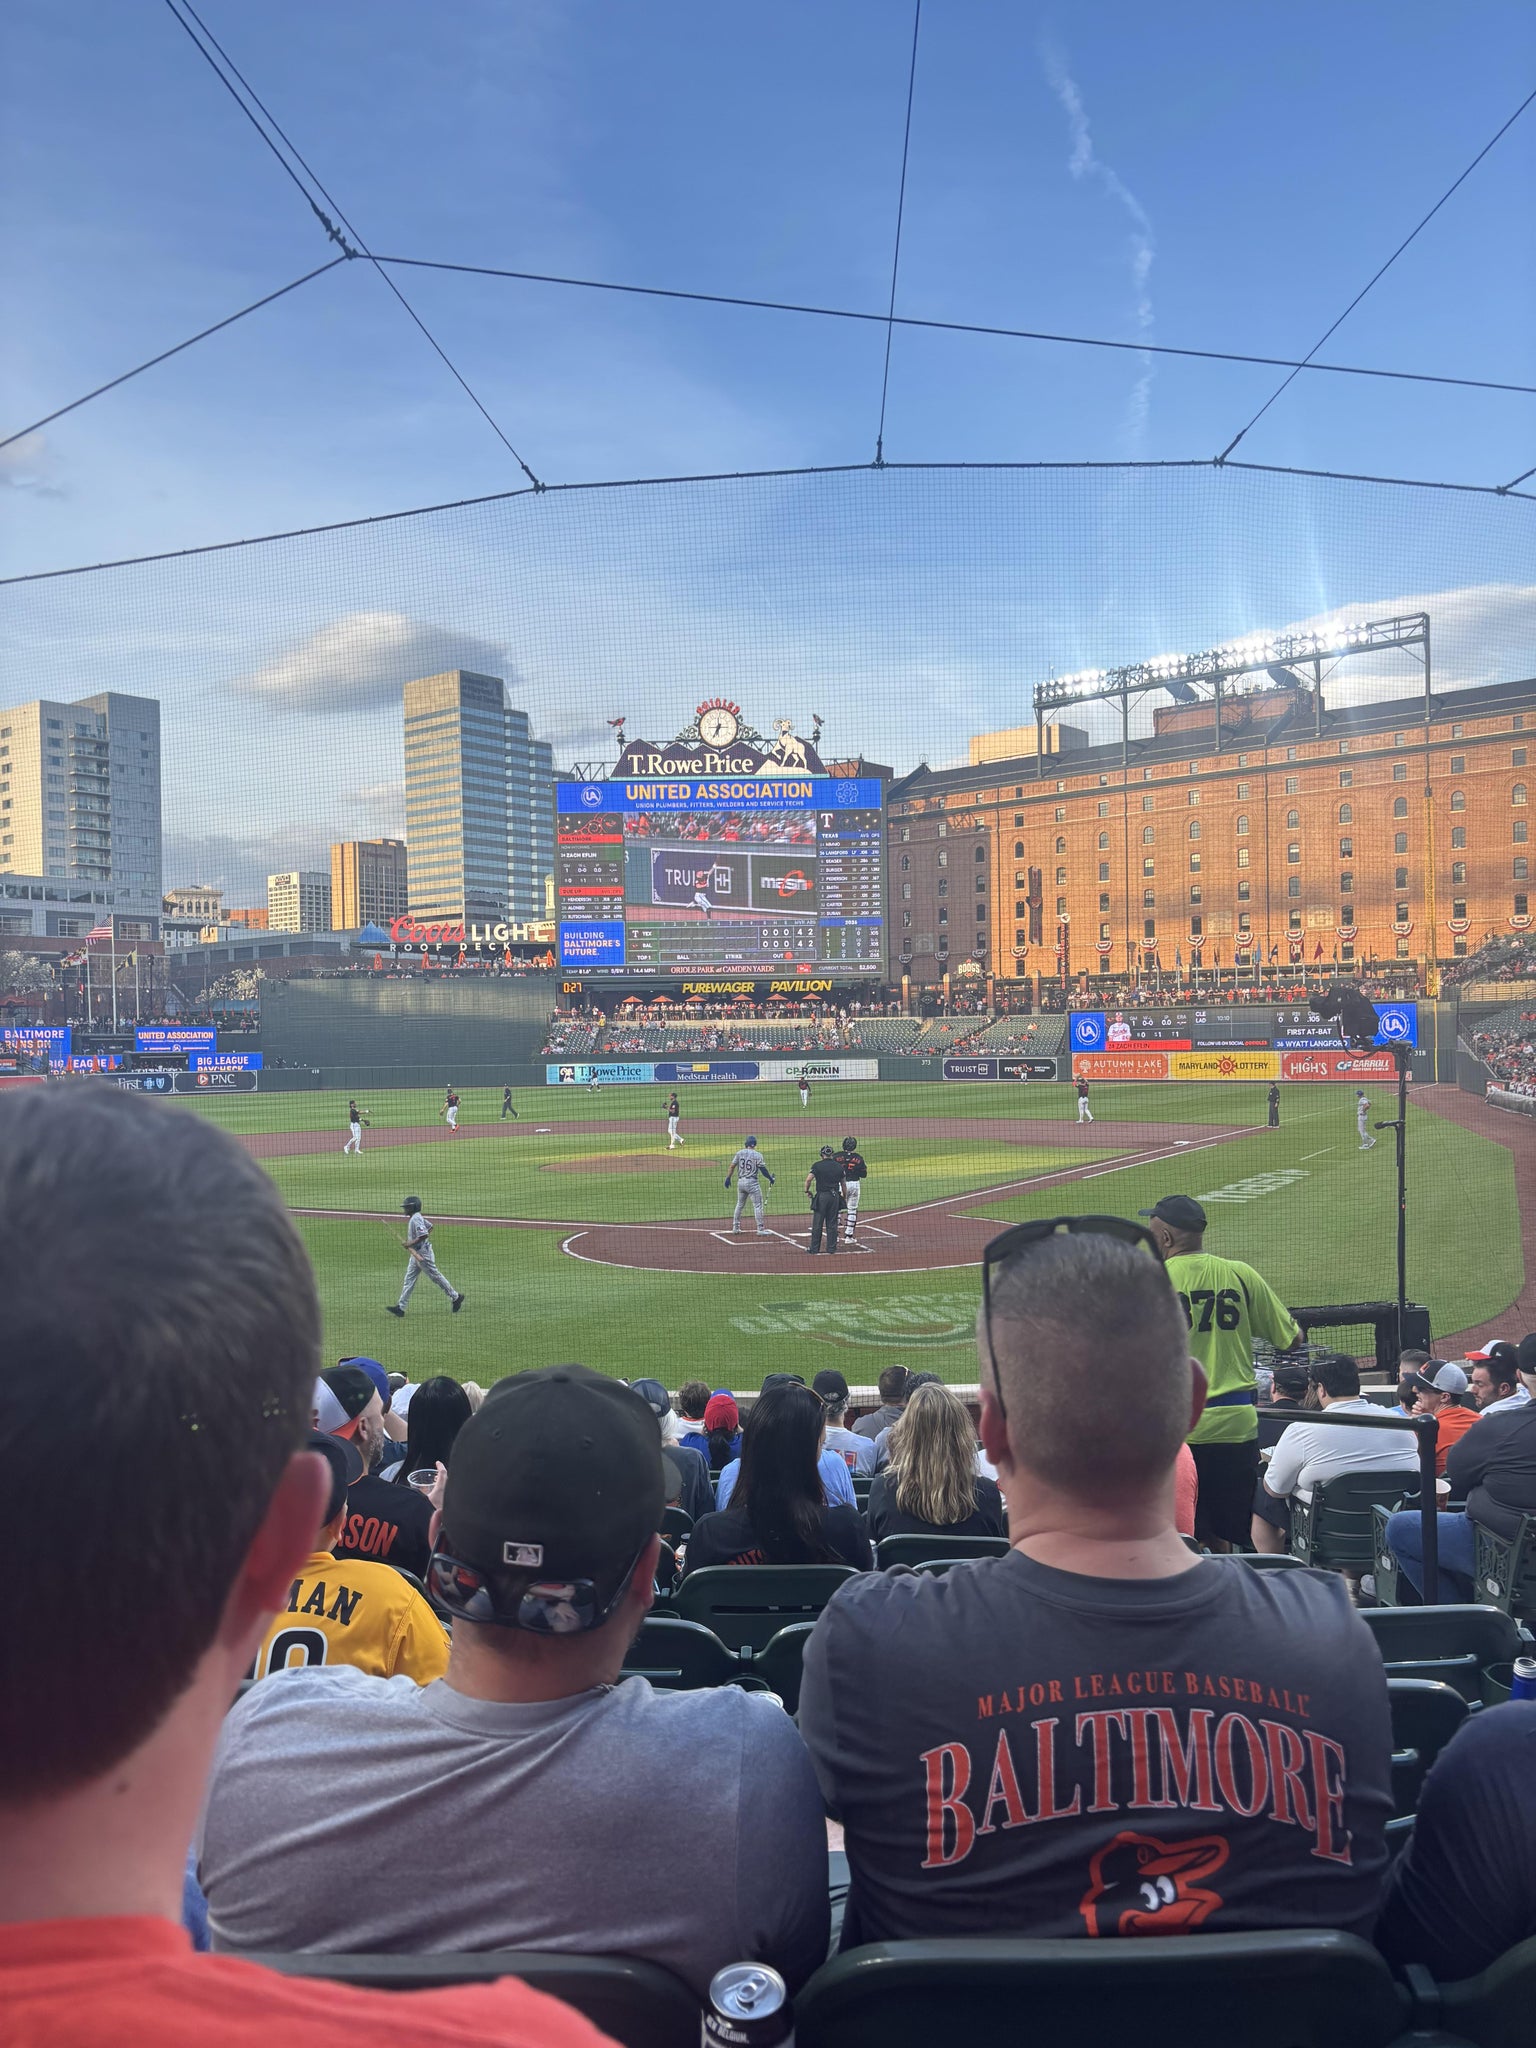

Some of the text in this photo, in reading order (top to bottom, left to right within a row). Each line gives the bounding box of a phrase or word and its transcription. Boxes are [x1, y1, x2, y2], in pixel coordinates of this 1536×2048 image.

[626, 782, 813, 800] UNITED ASSOCIATION
[821, 813, 833, 828] T
[389, 914, 550, 943] Coors LIGHT
[783, 928, 789, 936] 0
[797, 928, 803, 936] 4
[807, 928, 813, 936] 2
[564, 932, 605, 940] BUILDING
[390, 941, 511, 952] ROOF DECK
[564, 940, 620, 948] BALTIMORE'S
[773, 940, 779, 948] 0
[564, 948, 600, 956] FUTURE.
[670, 966, 697, 974] ORIOLE
[563, 982, 582, 993] 0:27
[681, 980, 832, 994] PUREWAGER PAVILION
[4, 1029, 65, 1039] BALTIMORE
[138, 1031, 214, 1039] UNITED ASSOCIATION
[197, 1056, 249, 1065] BIG LEAGUE
[1093, 1059, 1162, 1068] AUTUMN LAKE
[1352, 1059, 1390, 1068] CARROLL
[950, 1065, 977, 1073] TRUIST
[1179, 1062, 1268, 1070] MARYLAND LOTTERY
[1290, 1061, 1328, 1076] HIGH'S
[211, 1074, 235, 1084] PNC
[677, 1071, 737, 1080] MedStar Health
[740, 1158, 752, 1171] 36
[976, 1671, 1311, 1721] MAJOR LEAGUE BASEBALL
[920, 1707, 1354, 1870] BALTIMORE
